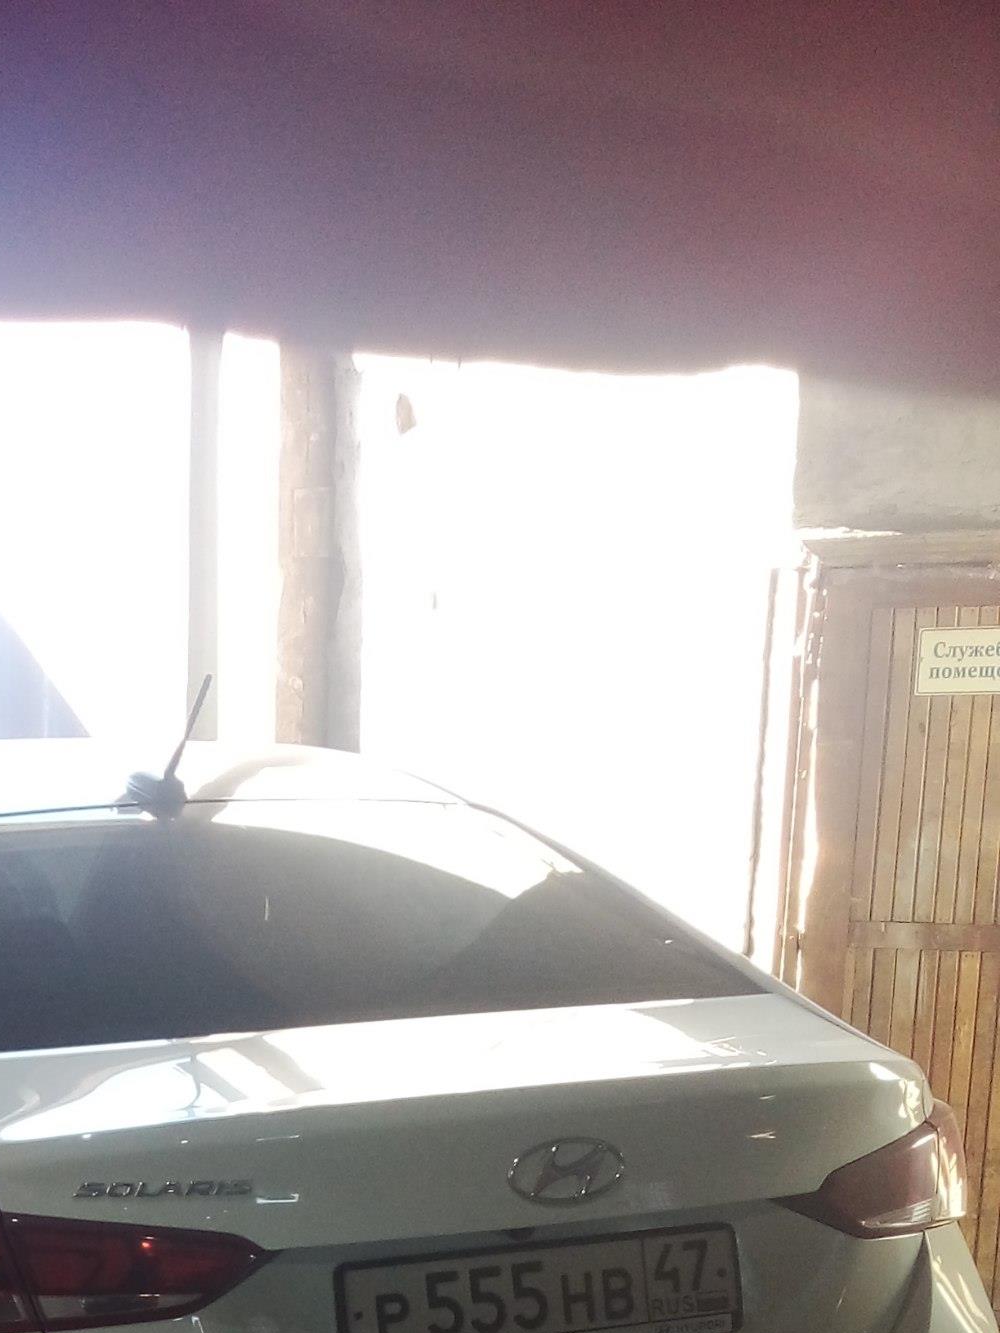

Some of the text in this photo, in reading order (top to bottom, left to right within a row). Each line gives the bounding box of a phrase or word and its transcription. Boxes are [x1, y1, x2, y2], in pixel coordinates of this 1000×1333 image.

[72, 1179, 252, 1198] SOLARIS
[653, 1240, 709, 1292] 47
[651, 1294, 695, 1315] RUS
